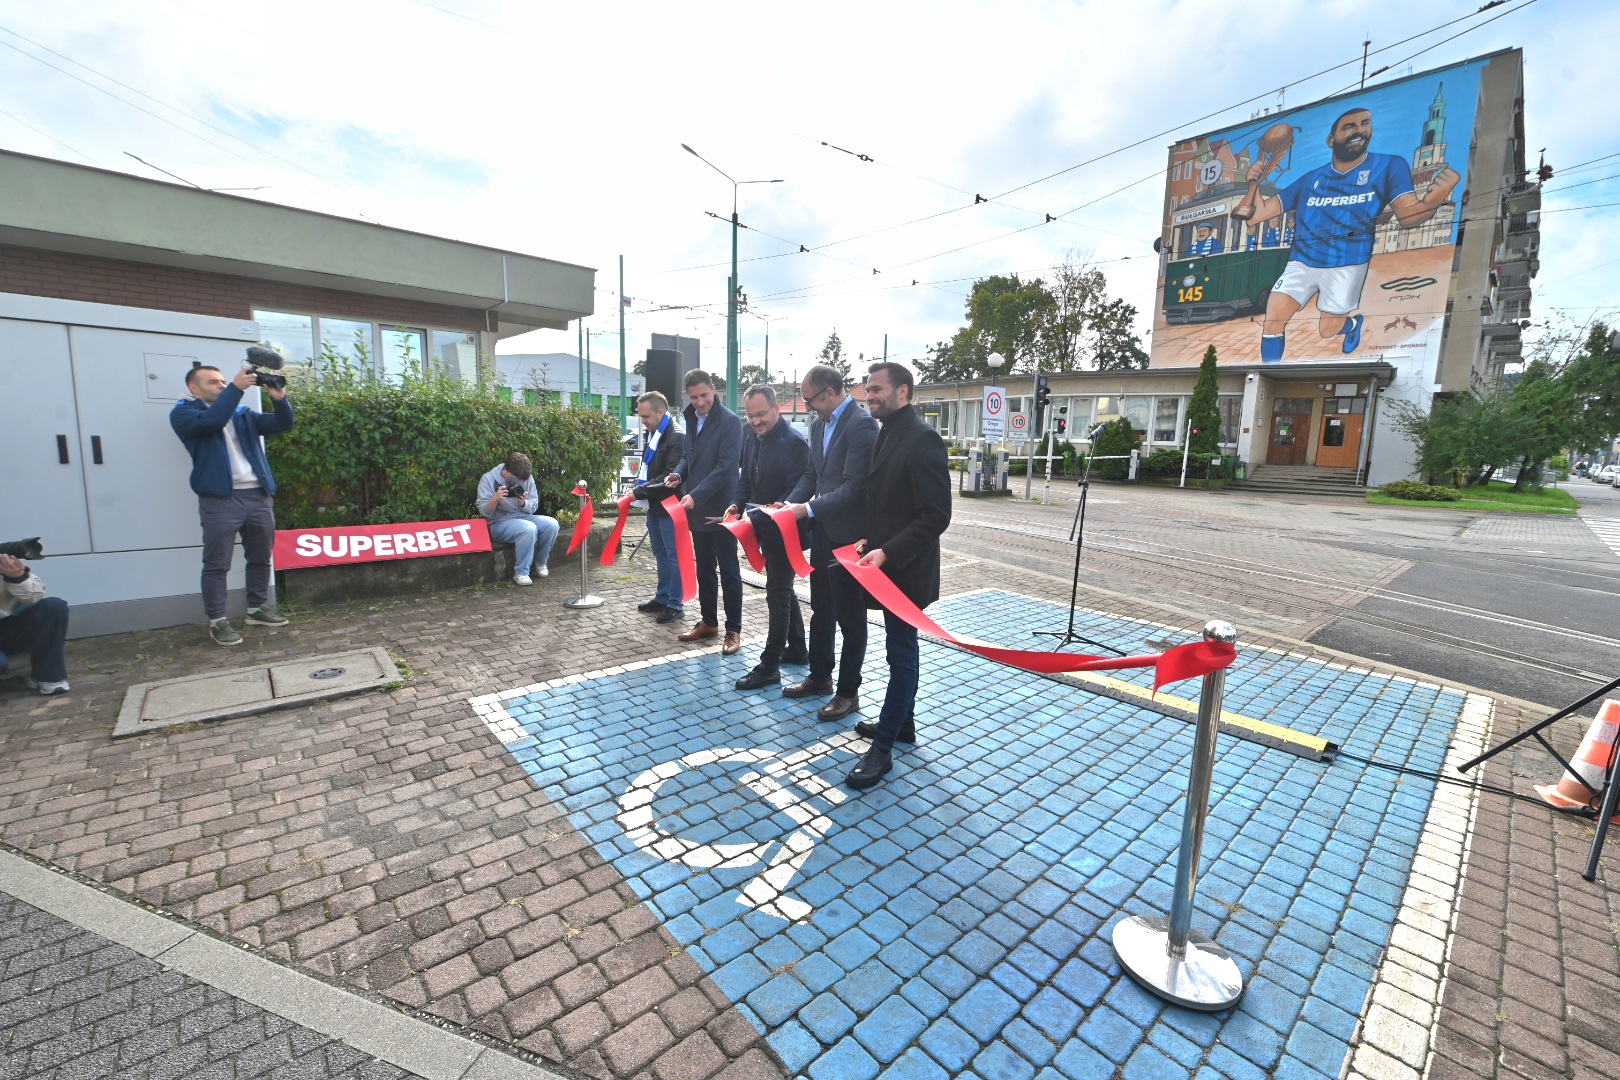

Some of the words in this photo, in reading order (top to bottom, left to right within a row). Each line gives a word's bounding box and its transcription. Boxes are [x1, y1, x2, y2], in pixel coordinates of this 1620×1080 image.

[1204, 166, 1216, 180] 15
[1306, 191, 1375, 206] SUPERBET
[1275, 279, 1283, 290] 9
[1178, 285, 1203, 303] 145
[990, 399, 999, 409] 10
[296, 524, 471, 557] SUPERBET
